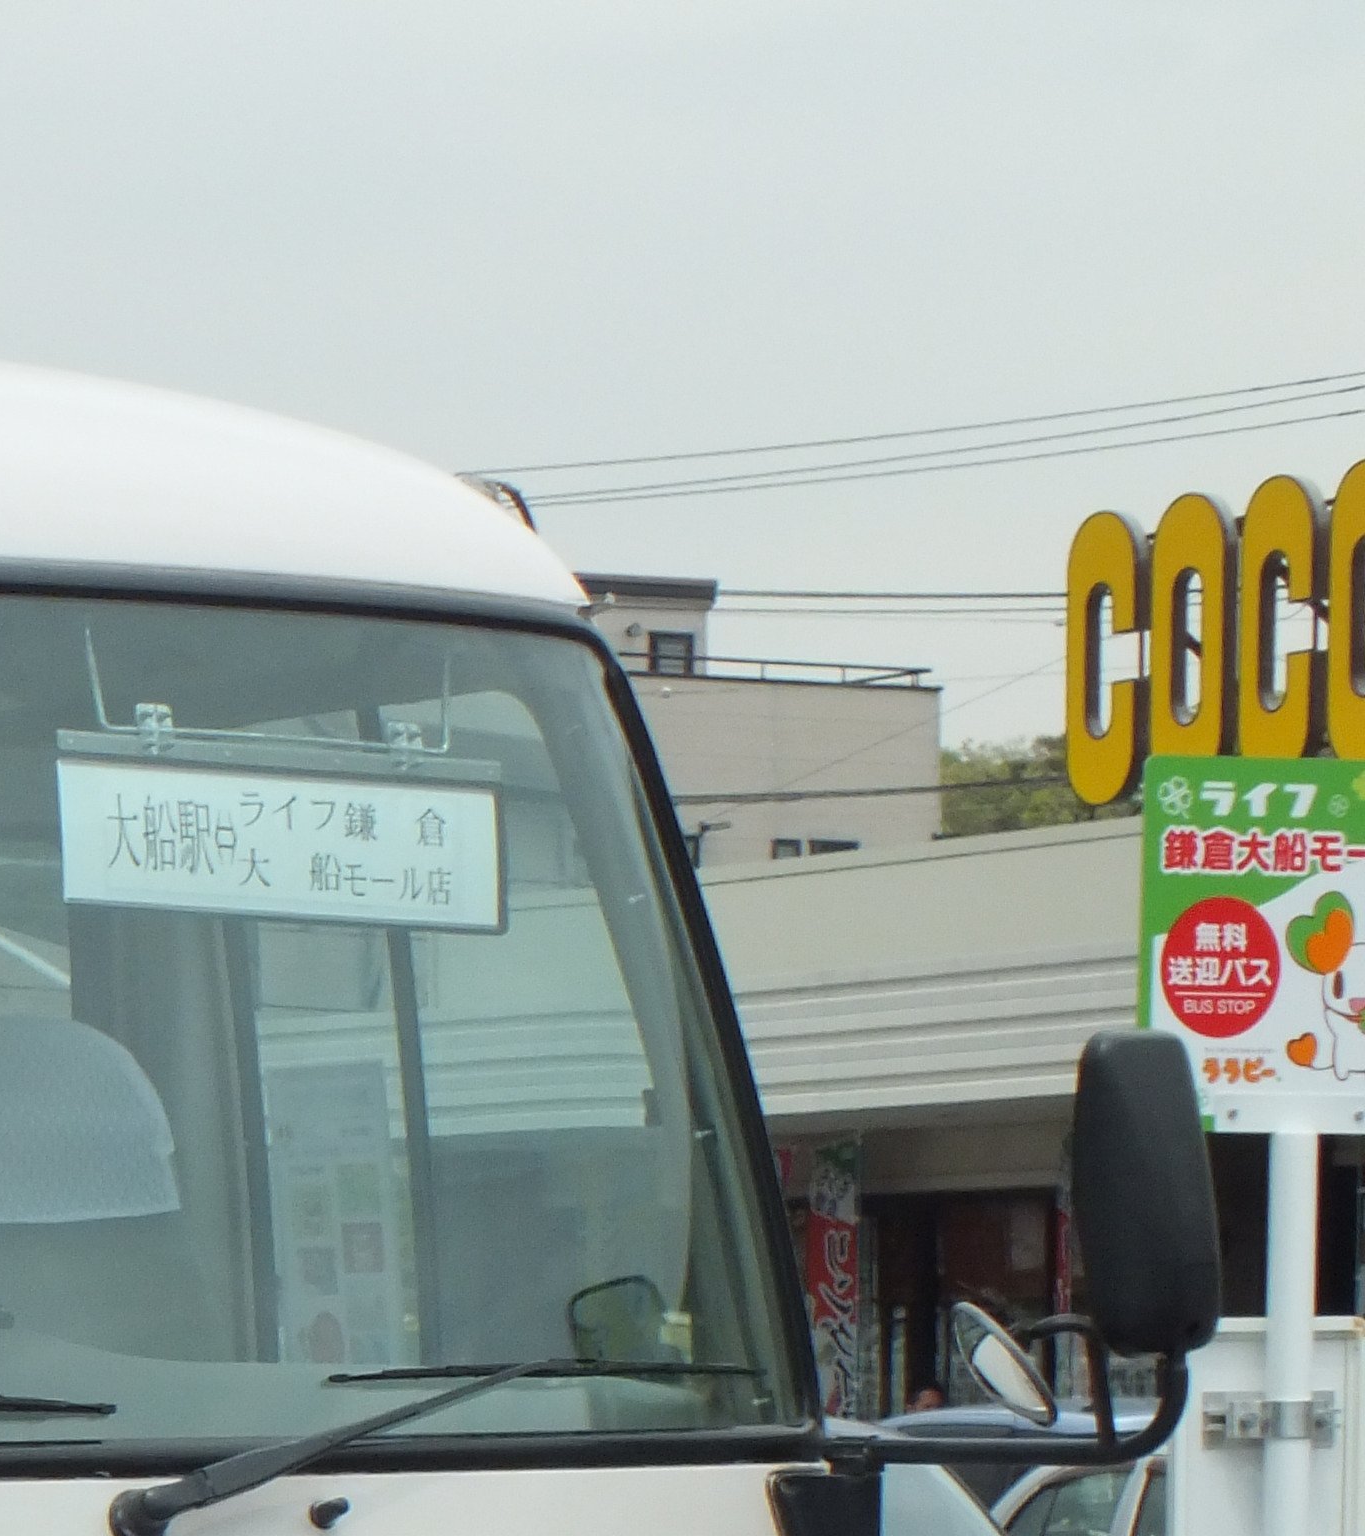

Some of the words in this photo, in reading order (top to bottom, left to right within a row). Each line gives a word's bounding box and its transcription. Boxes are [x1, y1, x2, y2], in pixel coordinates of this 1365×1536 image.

[1200, 781, 1318, 818] ライフ
[106, 794, 214, 875] 大船駅
[1195, 922, 1247, 952] 無料
[1168, 956, 1272, 986] 送迎バス
[1183, 999, 1213, 1014] BUS
[1217, 999, 1256, 1014] STOP
